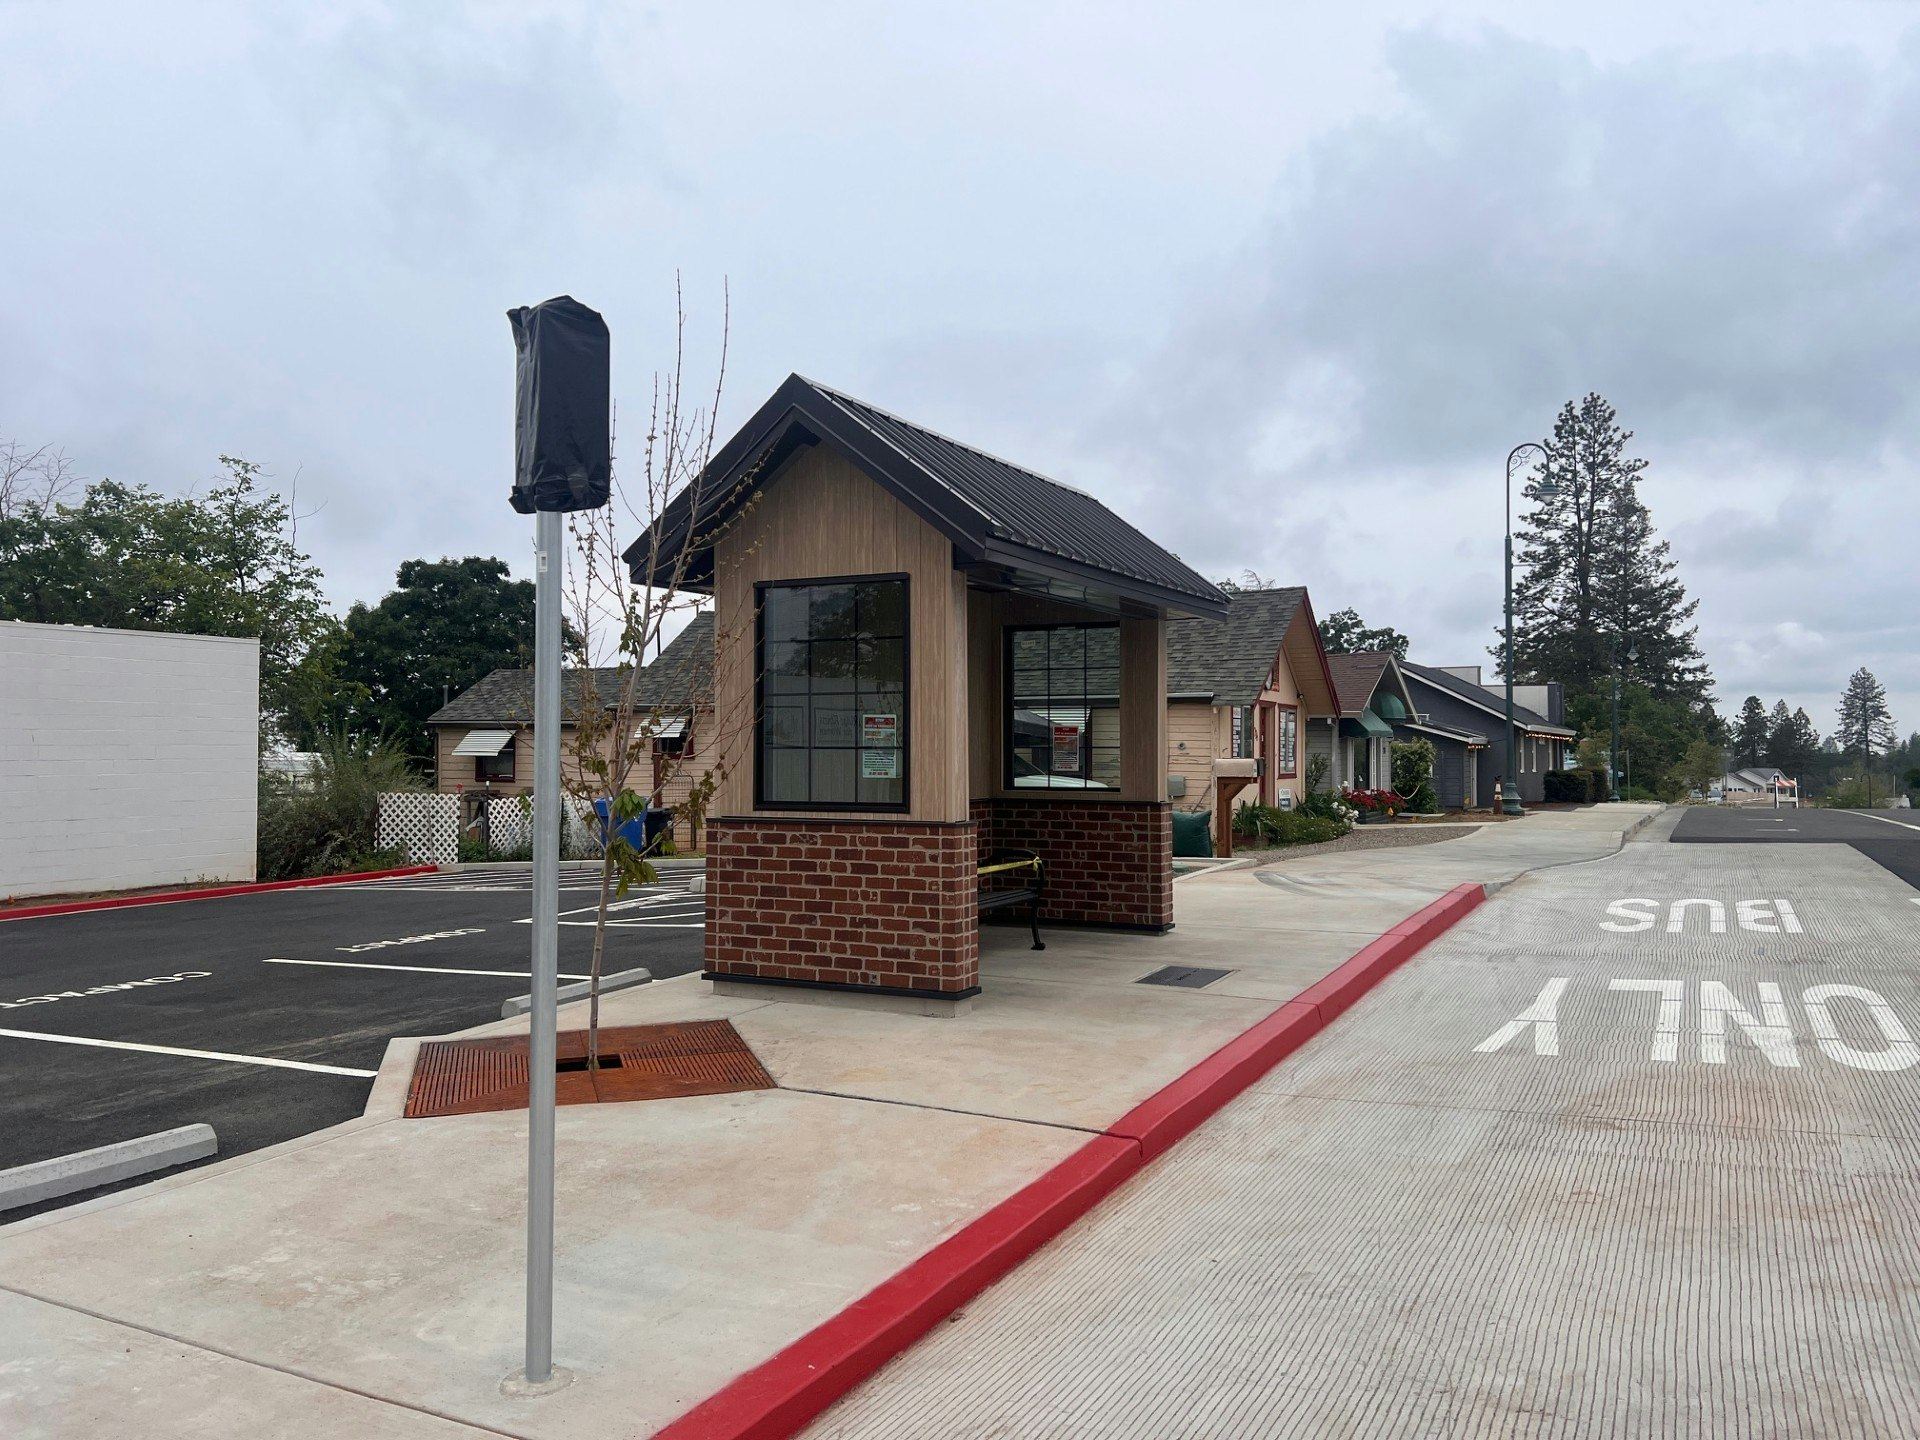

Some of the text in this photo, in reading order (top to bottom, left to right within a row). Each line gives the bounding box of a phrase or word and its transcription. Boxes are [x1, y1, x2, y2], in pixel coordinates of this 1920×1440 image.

[1598, 898, 1804, 934] BUS
[334, 928, 487, 953] COMPACT
[1471, 976, 1920, 1072] ONLY
